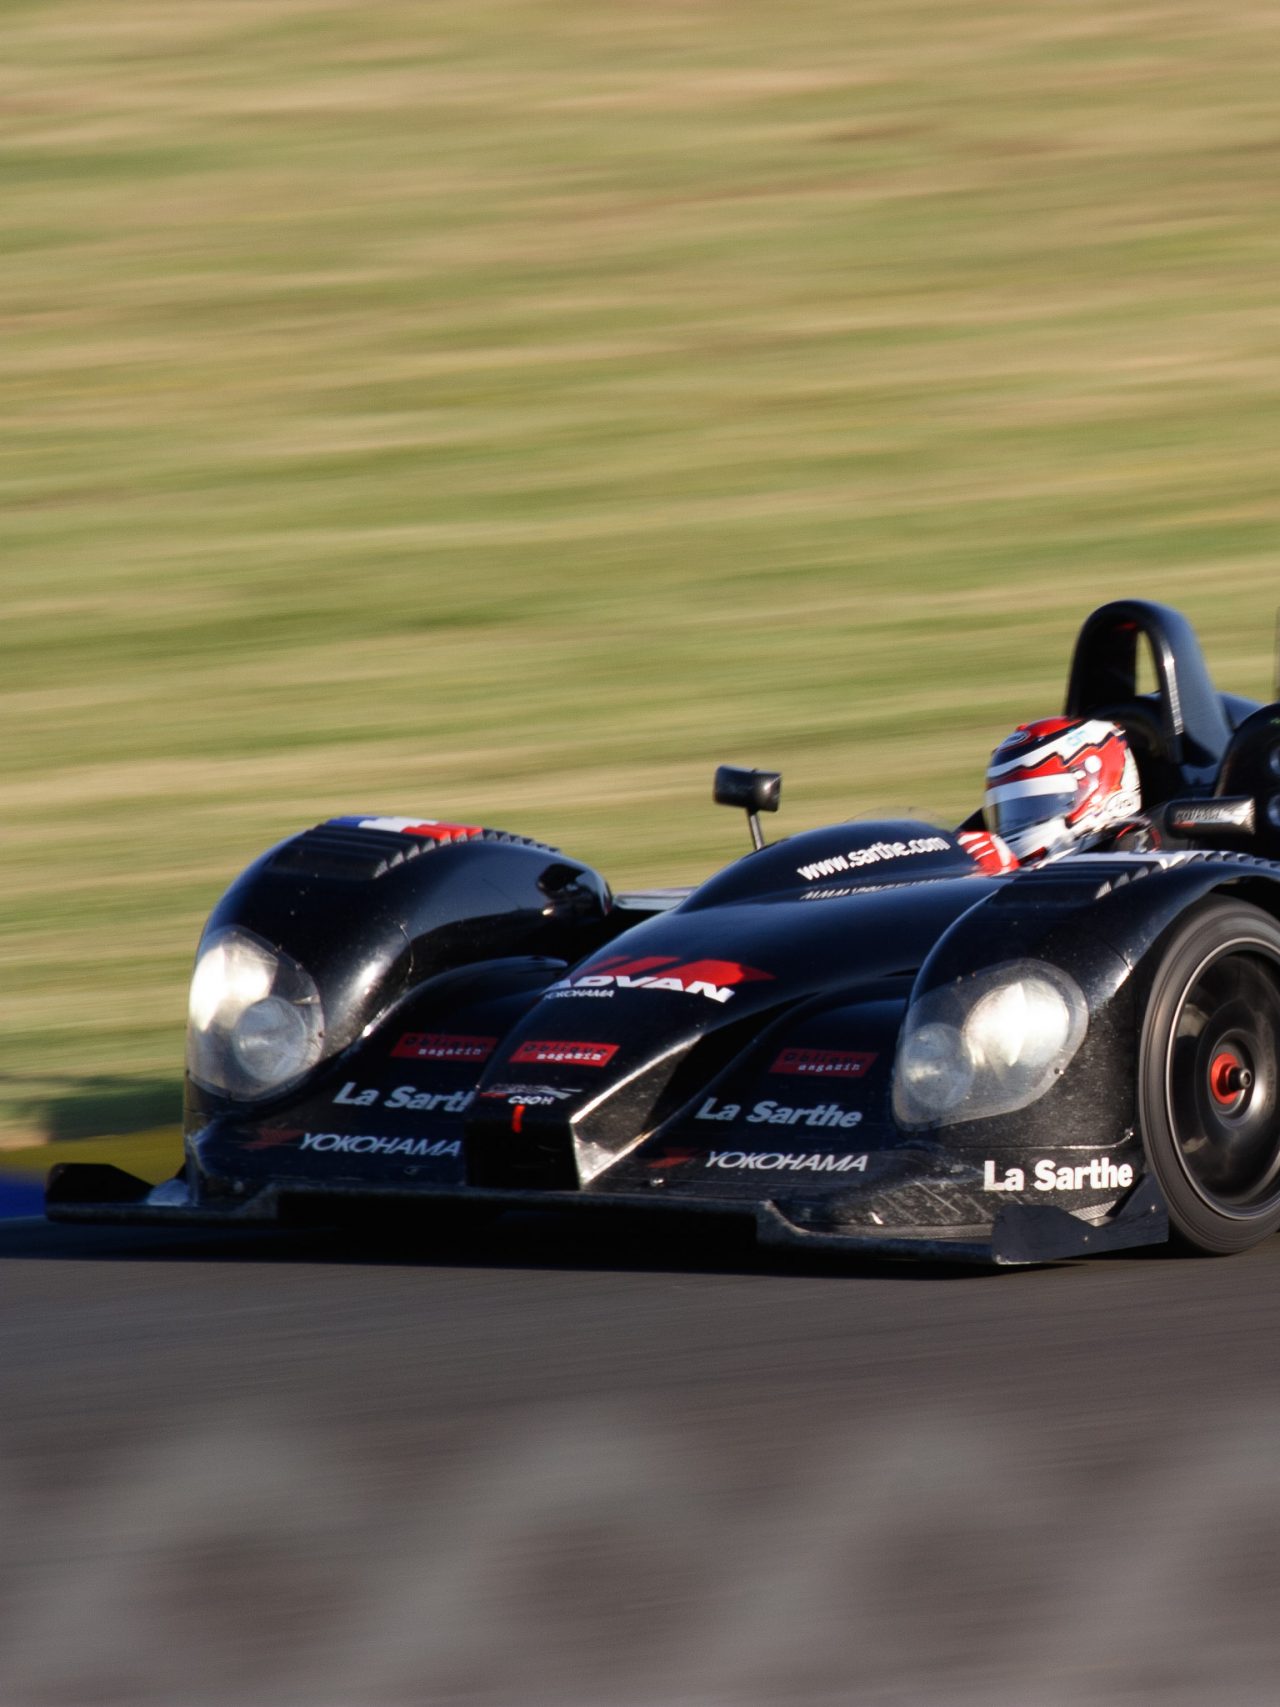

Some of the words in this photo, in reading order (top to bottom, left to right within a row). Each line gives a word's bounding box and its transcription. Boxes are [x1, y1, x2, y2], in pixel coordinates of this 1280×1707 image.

[796, 837, 951, 881] www.sarthe.com
[548, 975, 735, 1003] ADVAN
[332, 1082, 379, 1106] La
[384, 1086, 475, 1113] Sart
[695, 1097, 740, 1121] La
[746, 1100, 863, 1128] Sarthe
[299, 1132, 463, 1157] YOKOHAMA
[705, 1151, 868, 1172] YOKOHAMA
[984, 1160, 1024, 1191] La
[1033, 1157, 1133, 1191] Sarthe
